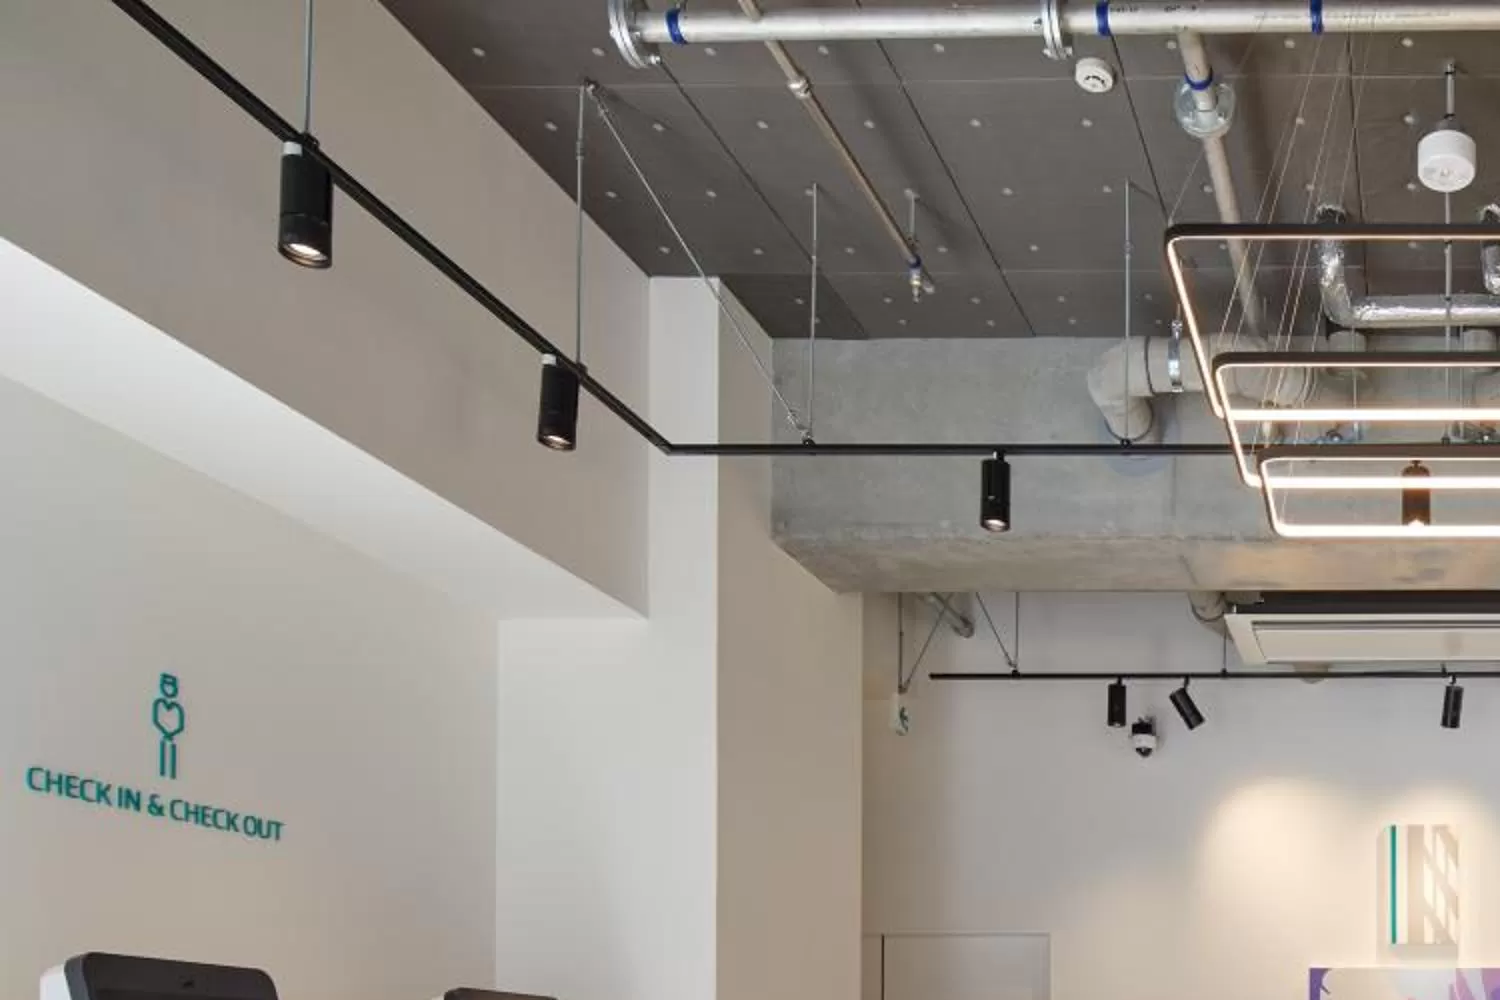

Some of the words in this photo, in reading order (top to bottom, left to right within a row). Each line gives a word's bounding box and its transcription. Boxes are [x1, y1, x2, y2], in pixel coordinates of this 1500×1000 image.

[26, 766, 112, 806] CHECK
[117, 786, 141, 812] IN
[147, 794, 165, 817] &
[169, 799, 240, 832] CHECK
[243, 815, 285, 841] OUT
